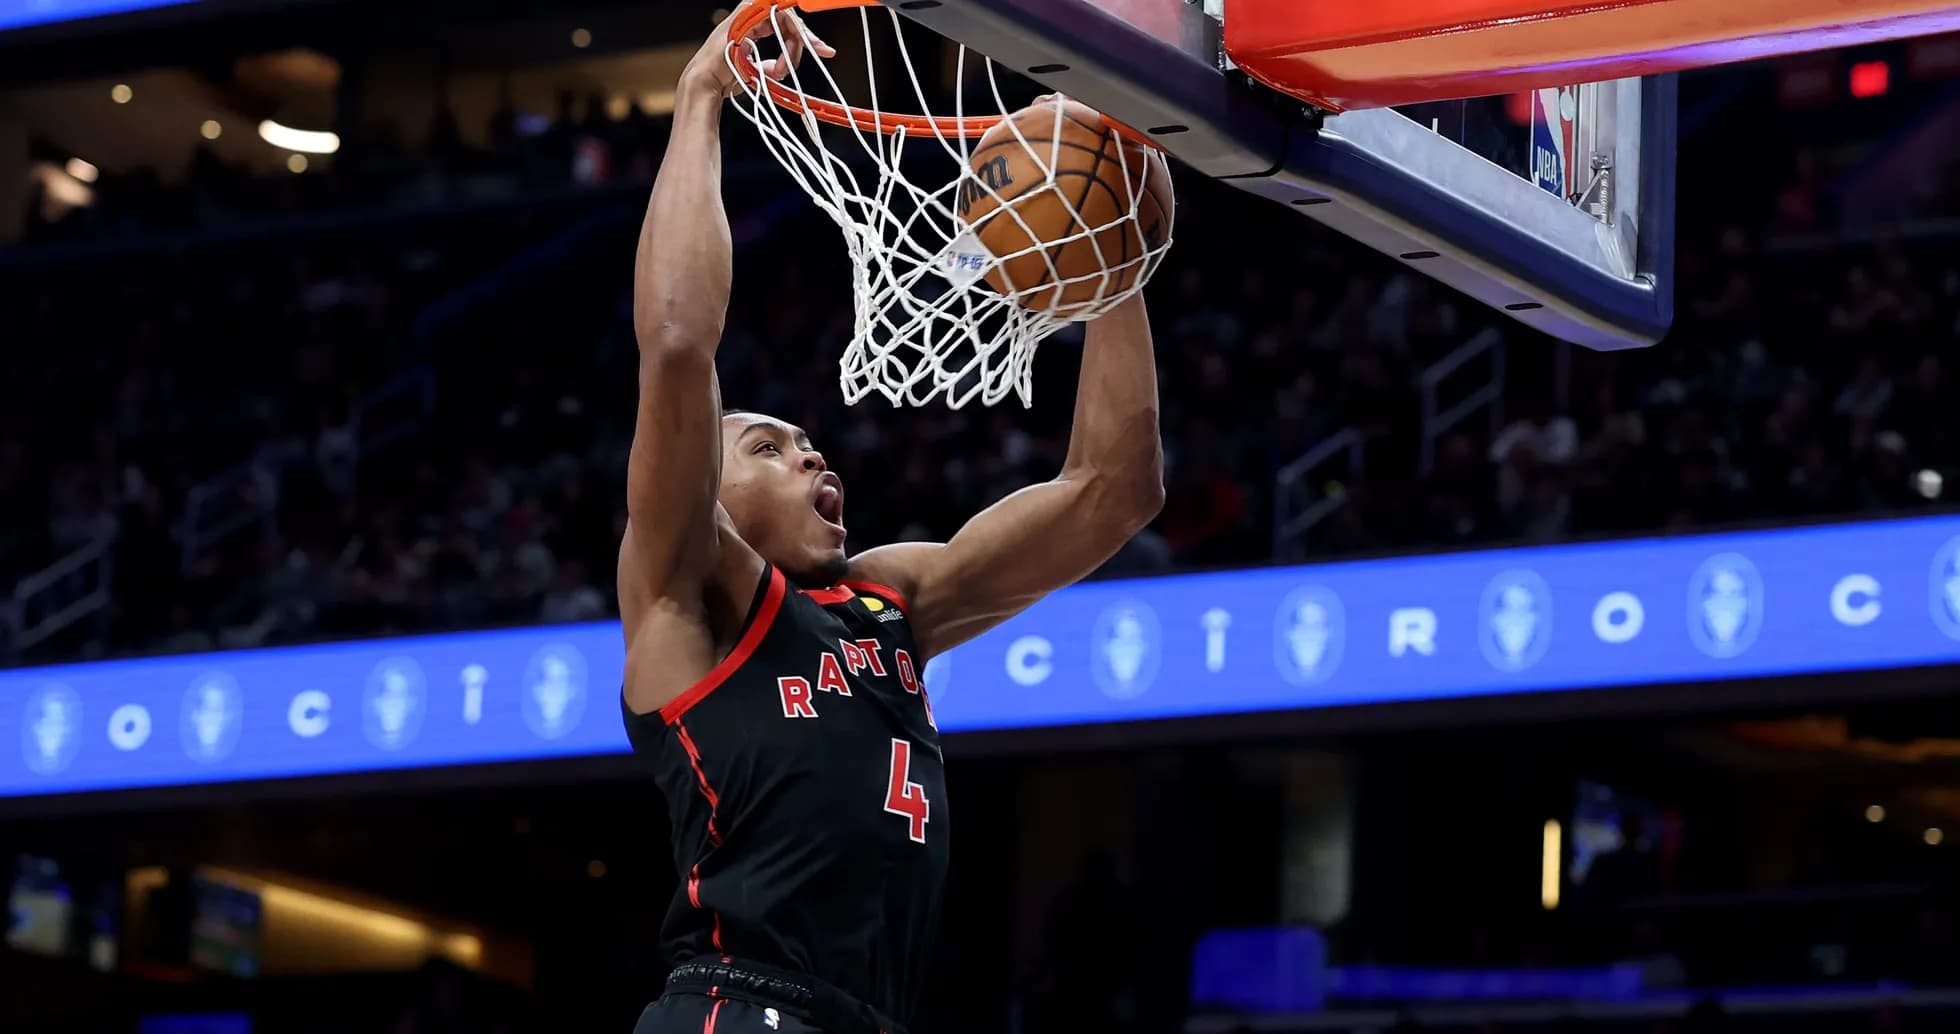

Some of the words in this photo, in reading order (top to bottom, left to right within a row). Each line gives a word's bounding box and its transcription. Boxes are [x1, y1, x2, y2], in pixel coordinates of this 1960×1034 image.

[1536, 144, 1557, 186] NBA
[777, 638, 938, 732] RAPTO
[883, 737, 930, 844] 4
